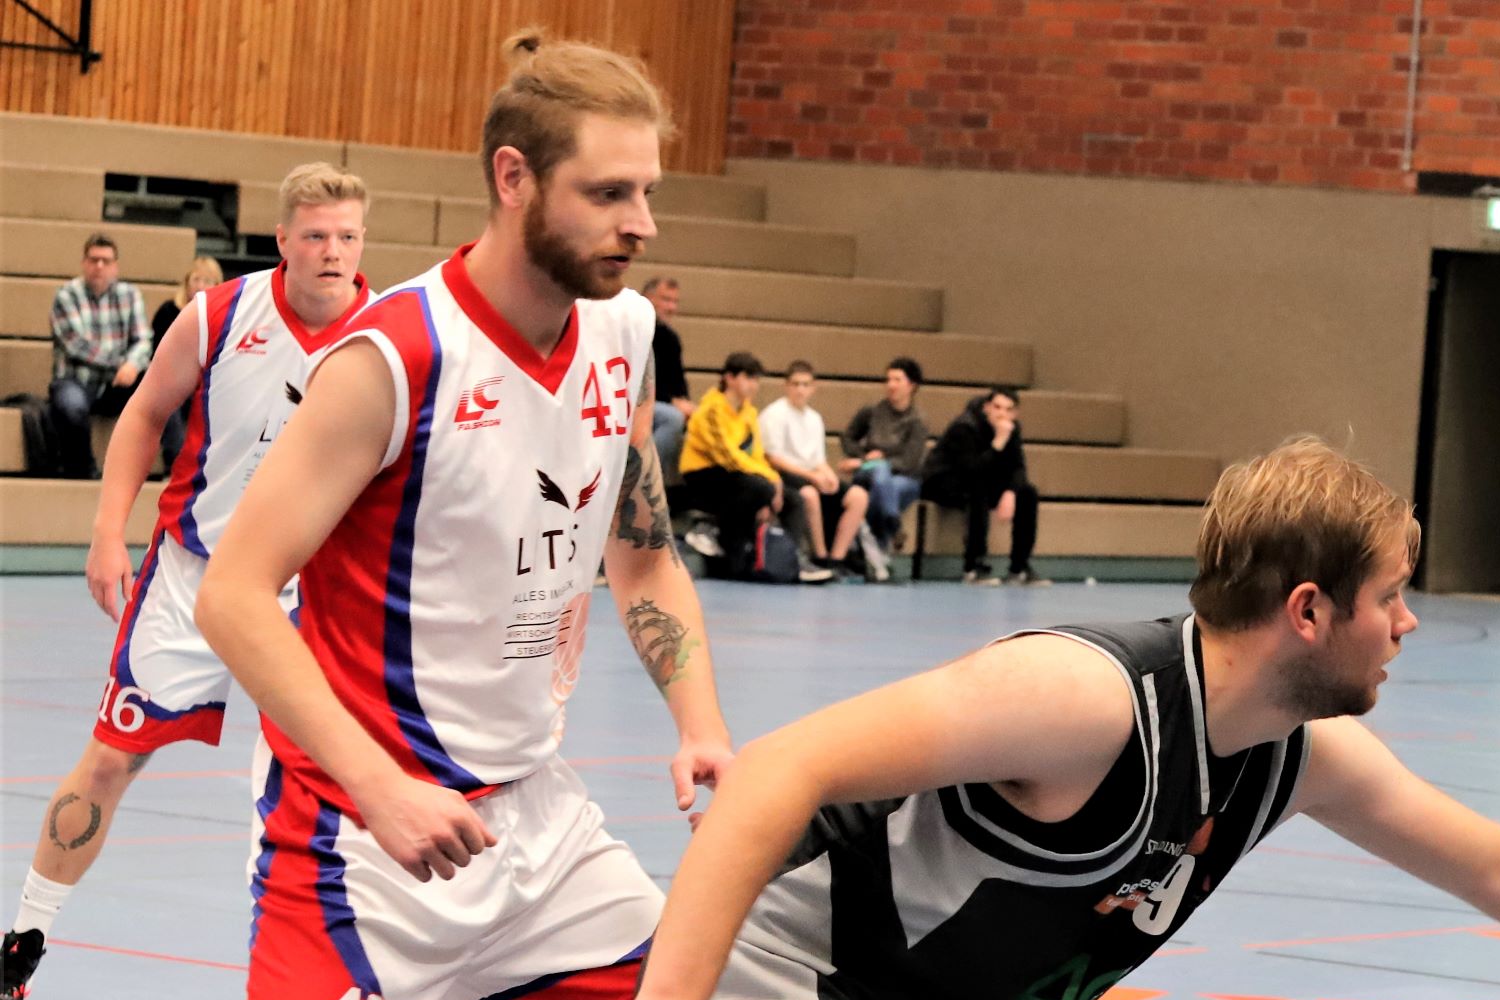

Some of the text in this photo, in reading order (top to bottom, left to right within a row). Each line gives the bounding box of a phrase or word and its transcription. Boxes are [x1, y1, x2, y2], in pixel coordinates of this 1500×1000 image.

[454, 375, 505, 422] LC
[581, 356, 631, 438] 43
[513, 590, 546, 604] ALLES
[99, 676, 150, 733] 16
[1132, 854, 1195, 936] 9
